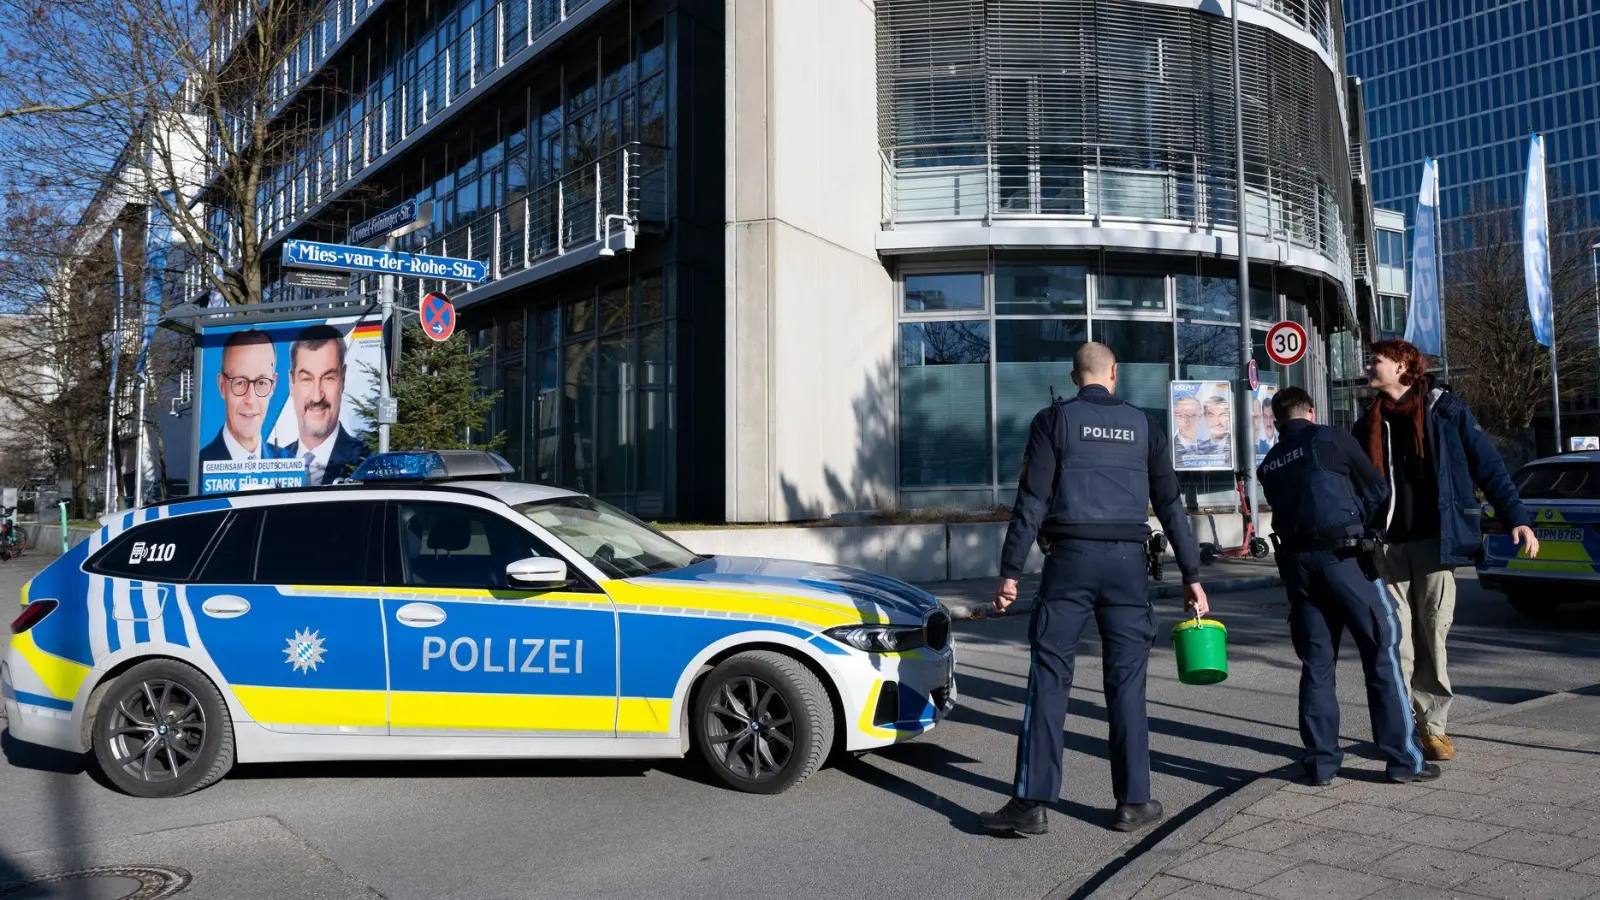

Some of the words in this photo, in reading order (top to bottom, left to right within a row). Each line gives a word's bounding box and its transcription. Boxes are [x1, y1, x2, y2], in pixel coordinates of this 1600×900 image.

[352, 205, 411, 243] Lyonel-Feininger-Str.
[298, 243, 476, 278] Mies-van-der-Rohe-Str.
[1274, 332, 1299, 353] 30
[1083, 426, 1135, 441] POLIZEI
[206, 463, 243, 471] GEMEINSAM
[245, 462, 257, 470] FÜR
[258, 461, 303, 470] DEUTSCHLAND
[1263, 447, 1304, 475] POLIZEI
[205, 478, 237, 492] STARK
[146, 543, 176, 562] 110
[422, 636, 583, 674] POLIZEI
